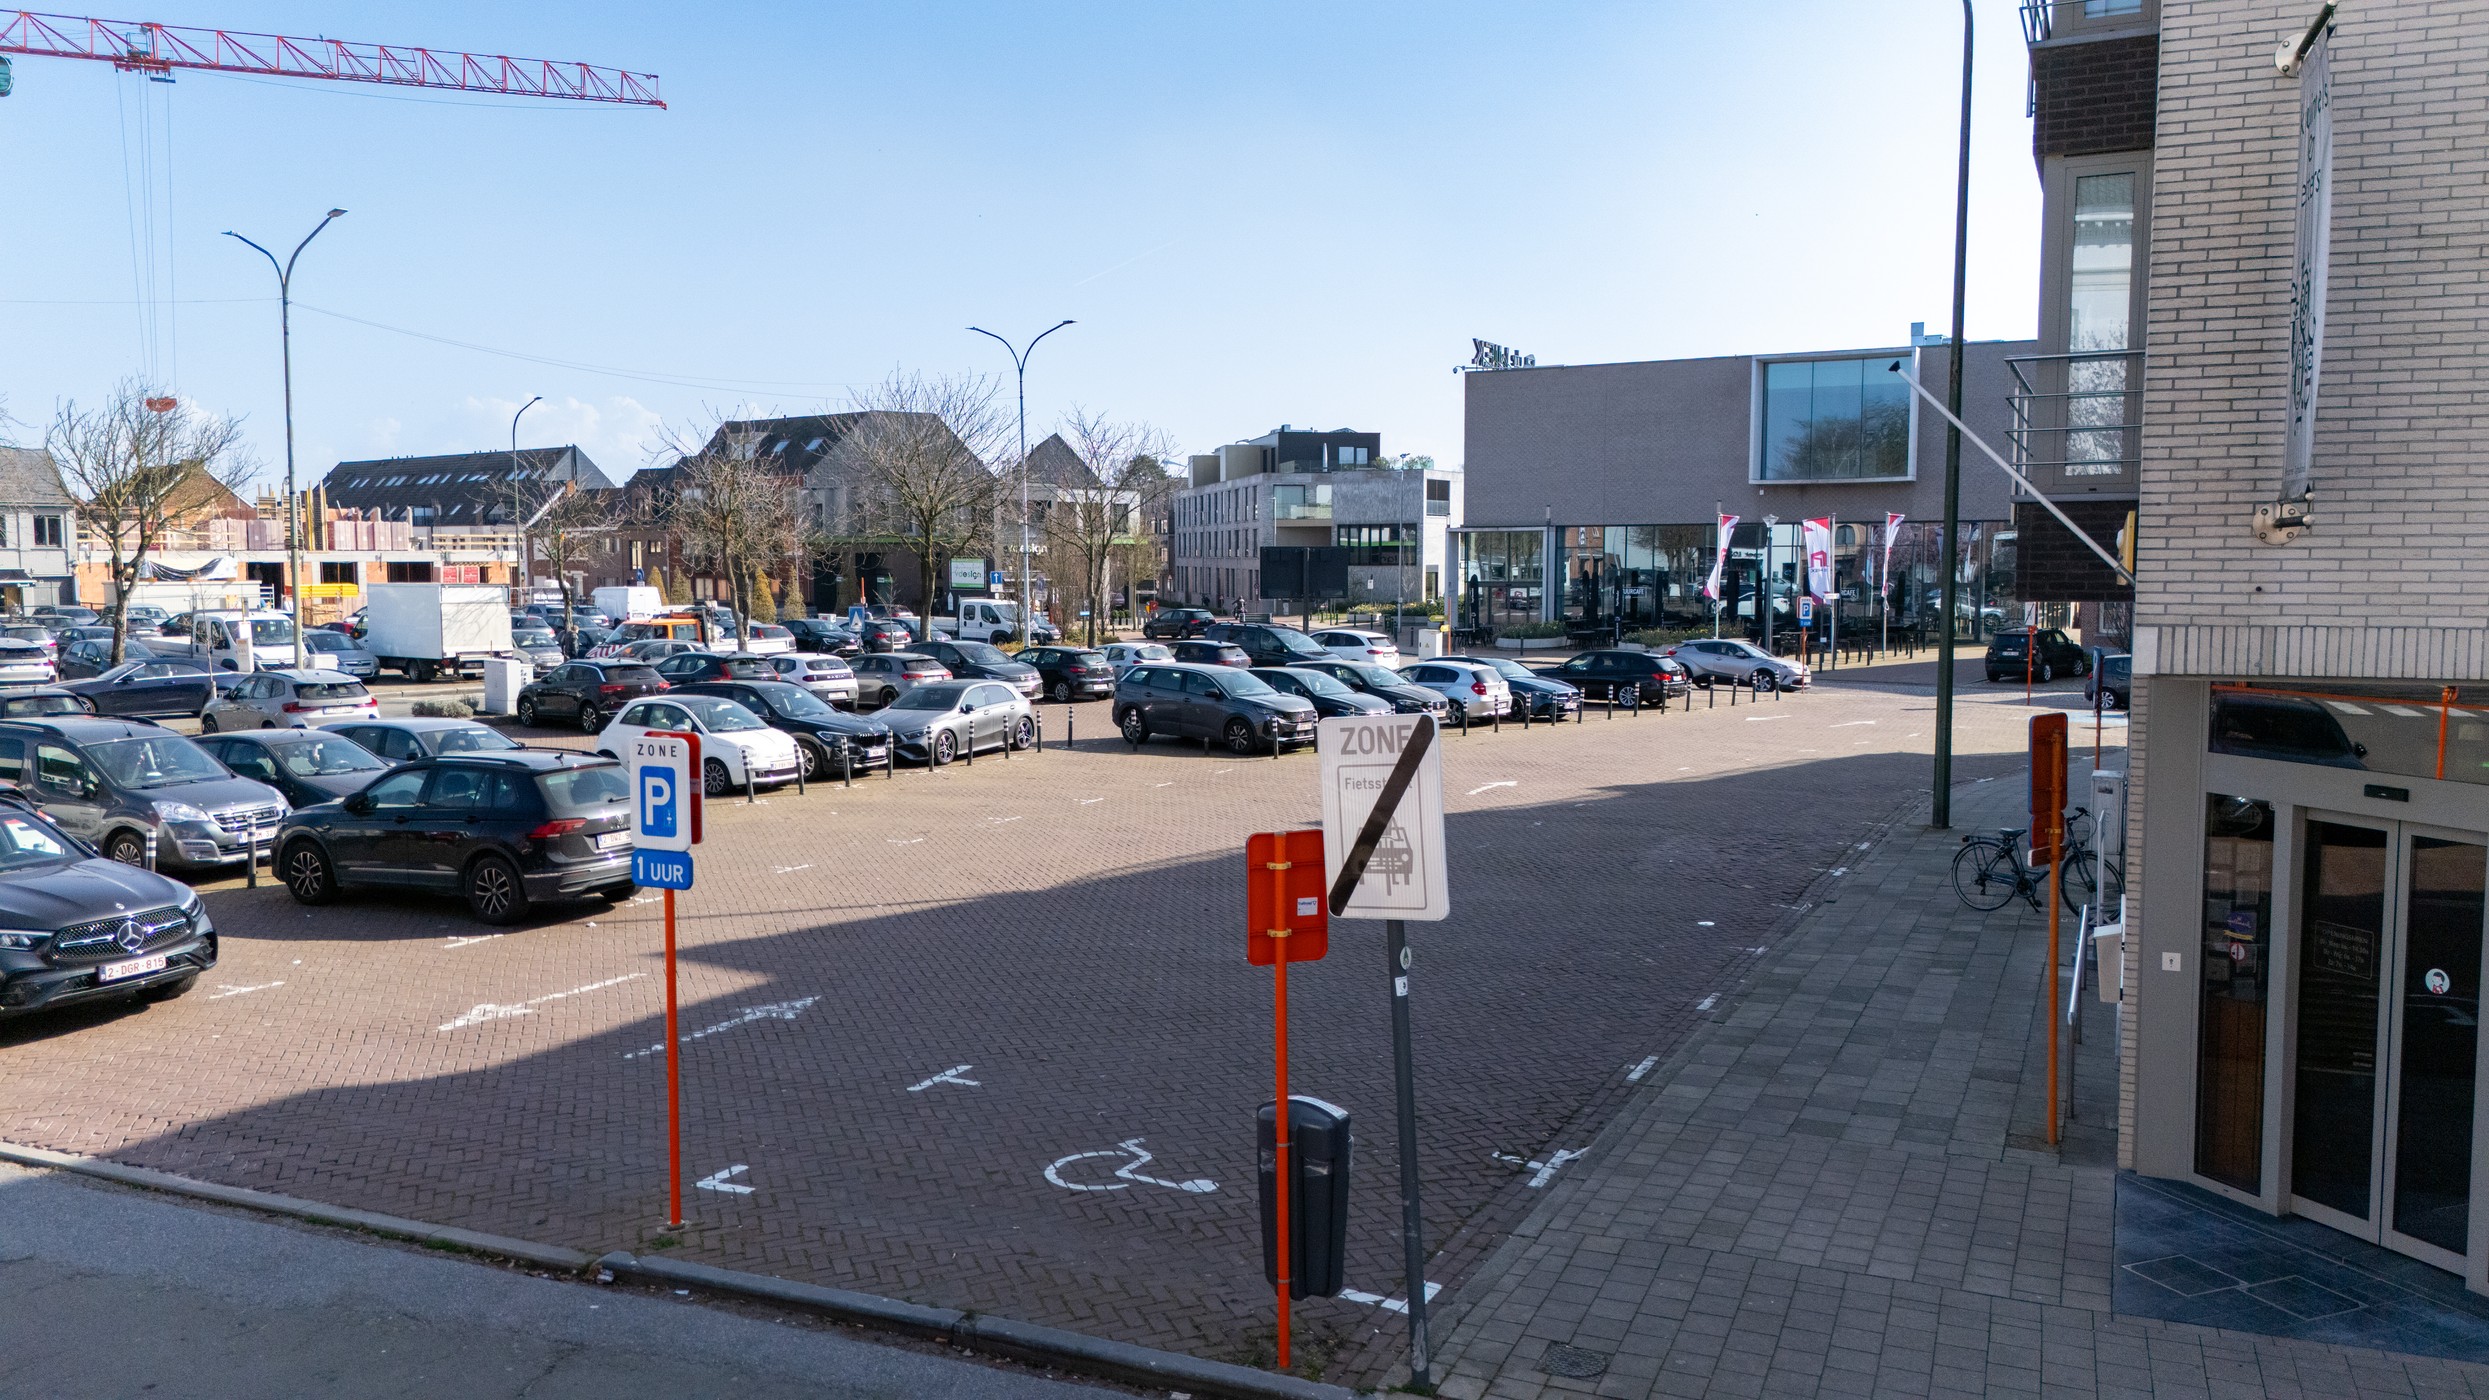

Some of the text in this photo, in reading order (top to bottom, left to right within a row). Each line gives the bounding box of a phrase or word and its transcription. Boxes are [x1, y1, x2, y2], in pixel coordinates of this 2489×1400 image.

[955, 569, 982, 580] vdesign
[637, 743, 678, 758] ZONE
[1339, 724, 1413, 756] ZONE
[644, 776, 671, 826] P
[637, 855, 684, 883] 1 UUR
[107, 957, 165, 978] 2-DGR-815
